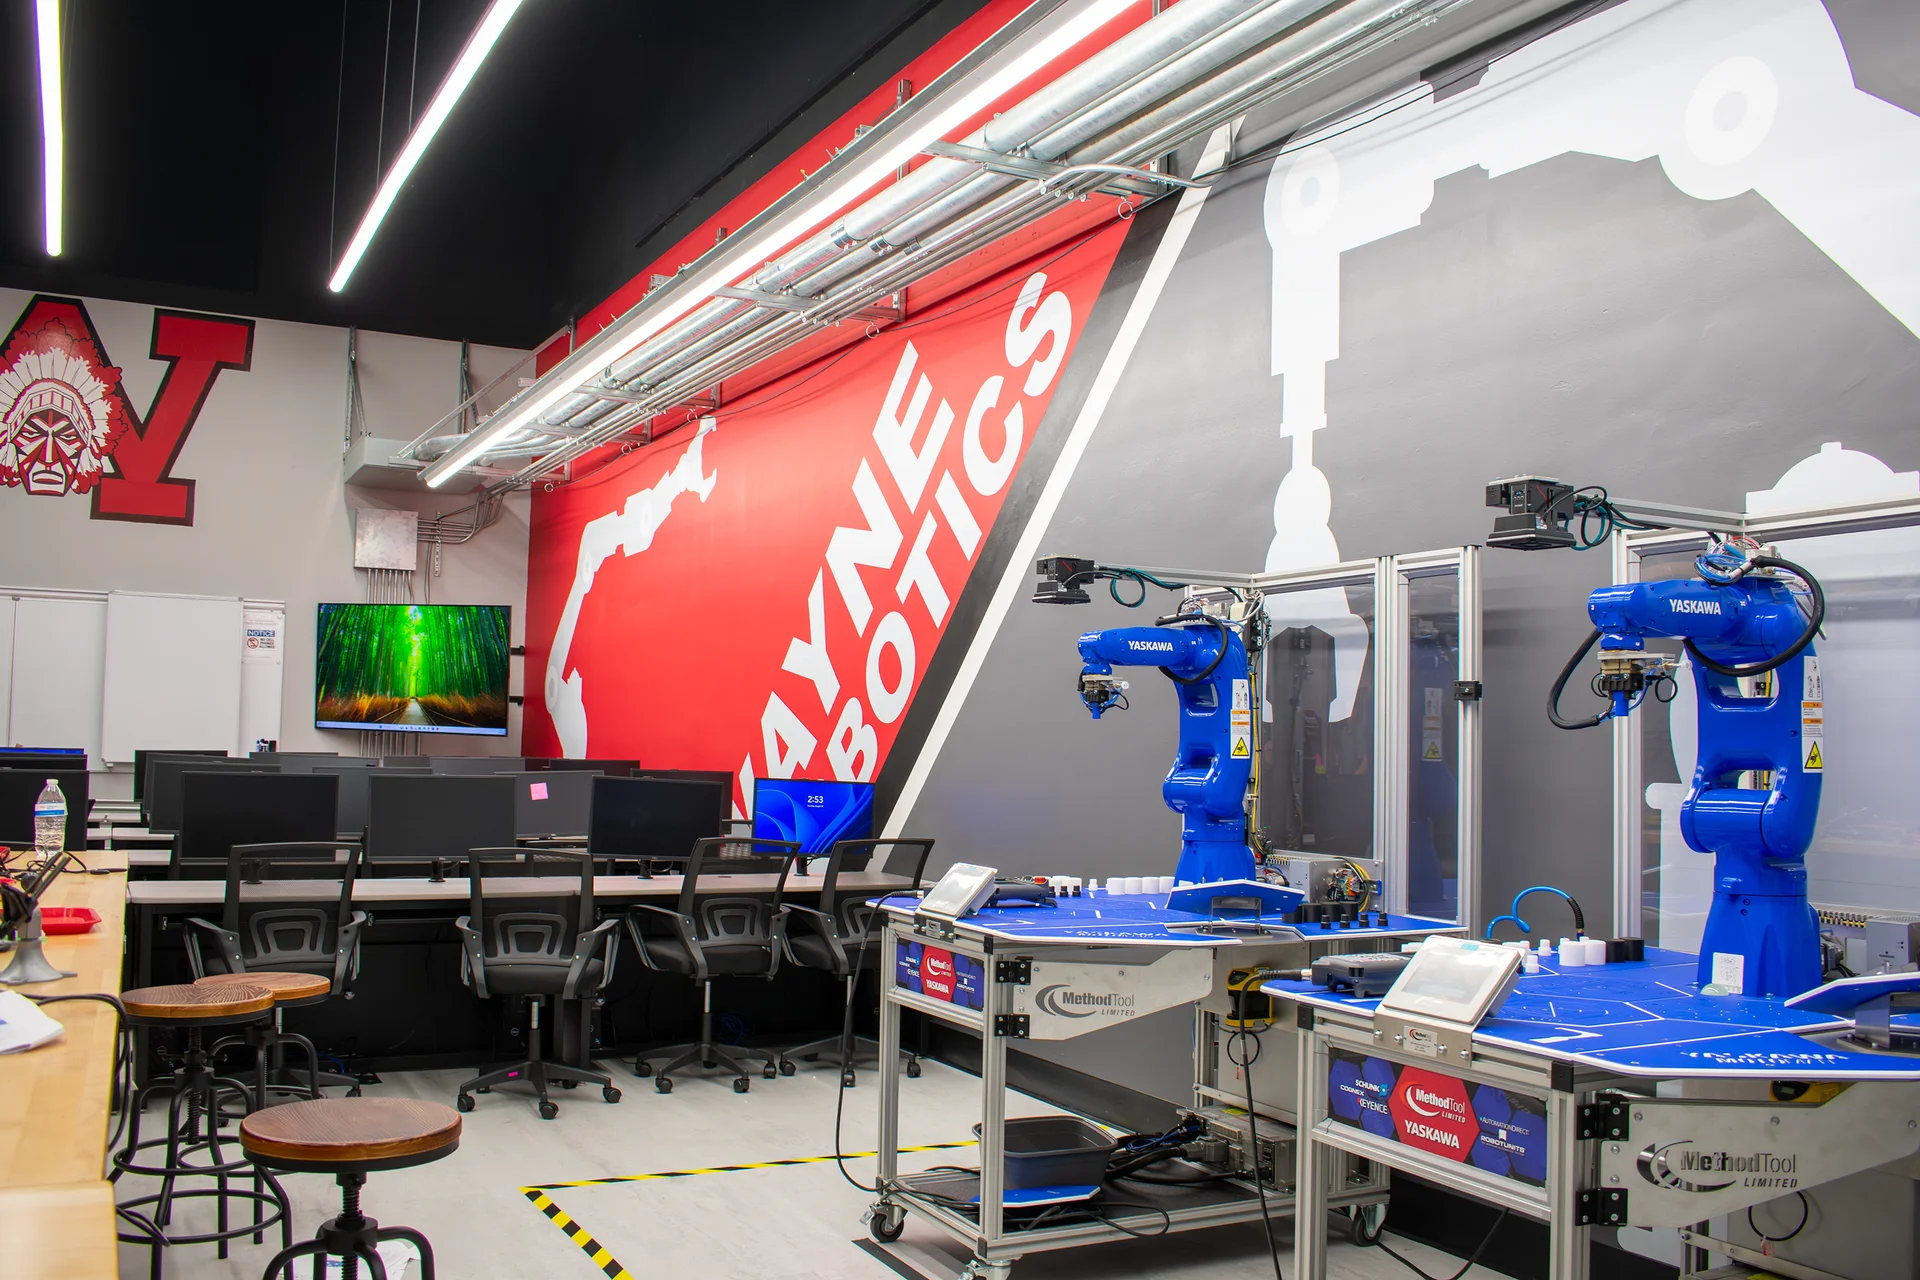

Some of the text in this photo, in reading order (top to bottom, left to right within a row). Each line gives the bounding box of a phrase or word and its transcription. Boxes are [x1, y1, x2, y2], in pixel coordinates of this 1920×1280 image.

[816, 271, 1072, 782] BOTICS
[1669, 599, 1722, 615] YASKAWA
[1128, 641, 1174, 651] YASKAWA
[807, 795, 824, 804] 2:53
[926, 979, 949, 994] YASKAWA
[1062, 991, 1135, 1007] MethodTool
[1355, 1079, 1380, 1093] SCHUNK
[1357, 1098, 1388, 1114] KEYENCE
[1415, 1088, 1466, 1114] MethodTool
[1441, 1110, 1466, 1123] LIMITED
[1404, 1120, 1460, 1149] YASKAWA
[1481, 1135, 1526, 1153] ROBOTUNITS
[1680, 1151, 1796, 1173] MethodTool
[1744, 1177, 1798, 1188] LIMITED
